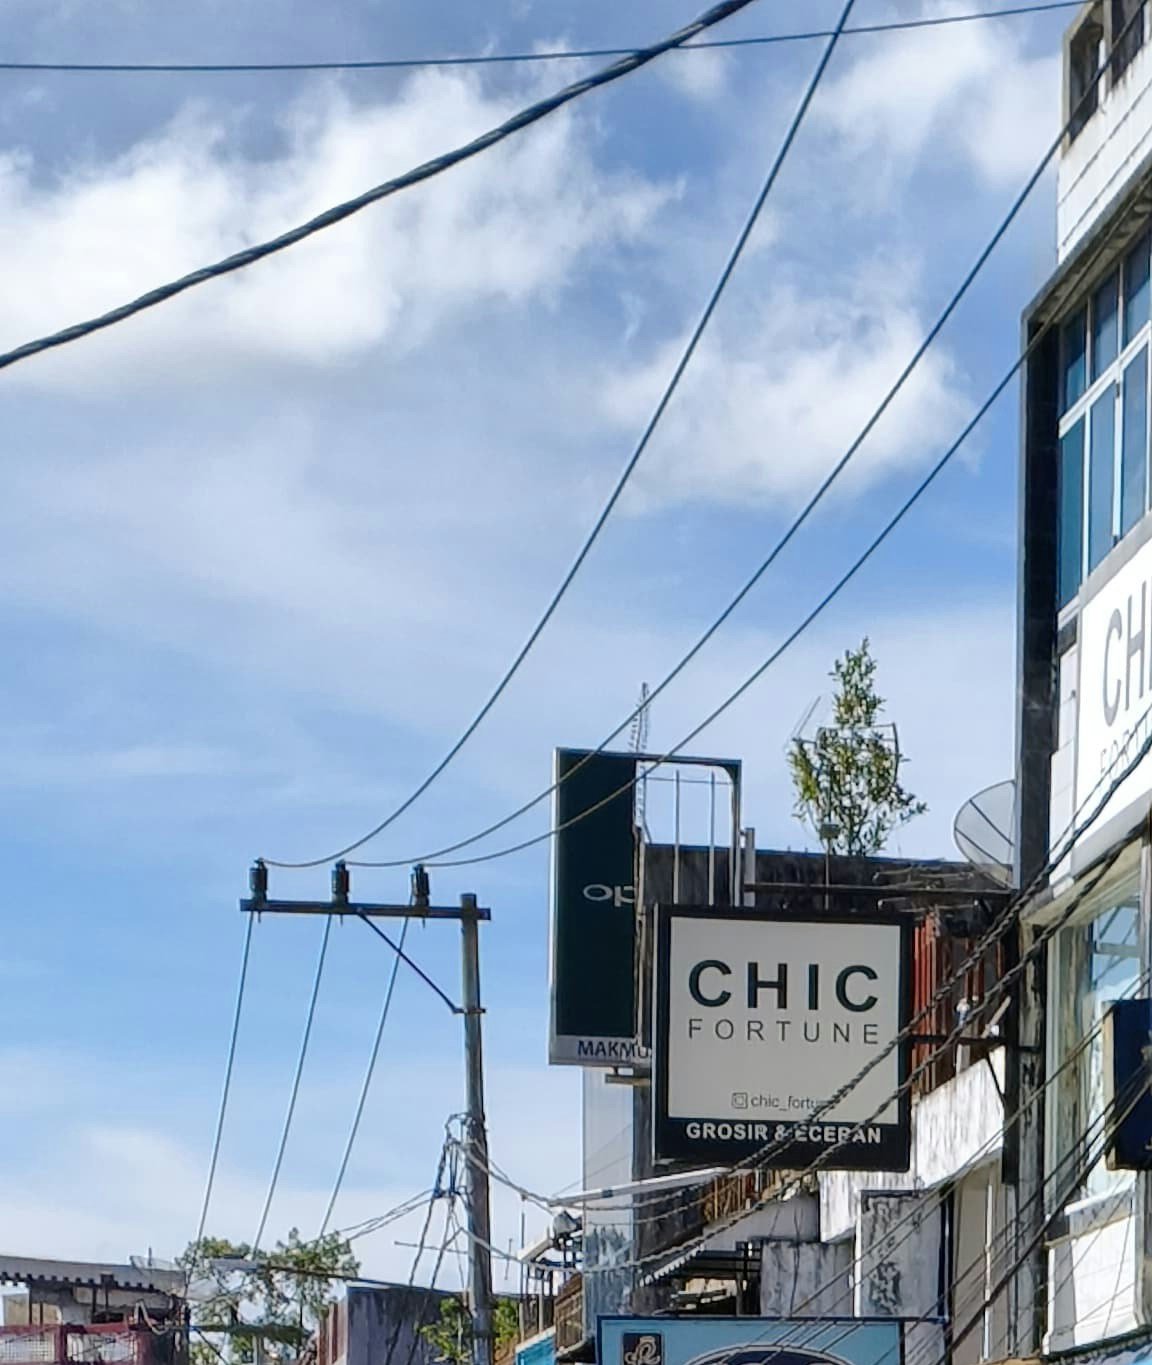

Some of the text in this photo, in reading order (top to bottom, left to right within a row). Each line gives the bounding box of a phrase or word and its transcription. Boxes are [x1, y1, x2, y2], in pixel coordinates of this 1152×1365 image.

[688, 958, 878, 1012] CHIC
[688, 1018, 879, 1045] FORTUNE
[686, 1121, 768, 1141] GROSIR
[775, 1124, 789, 1141] &
